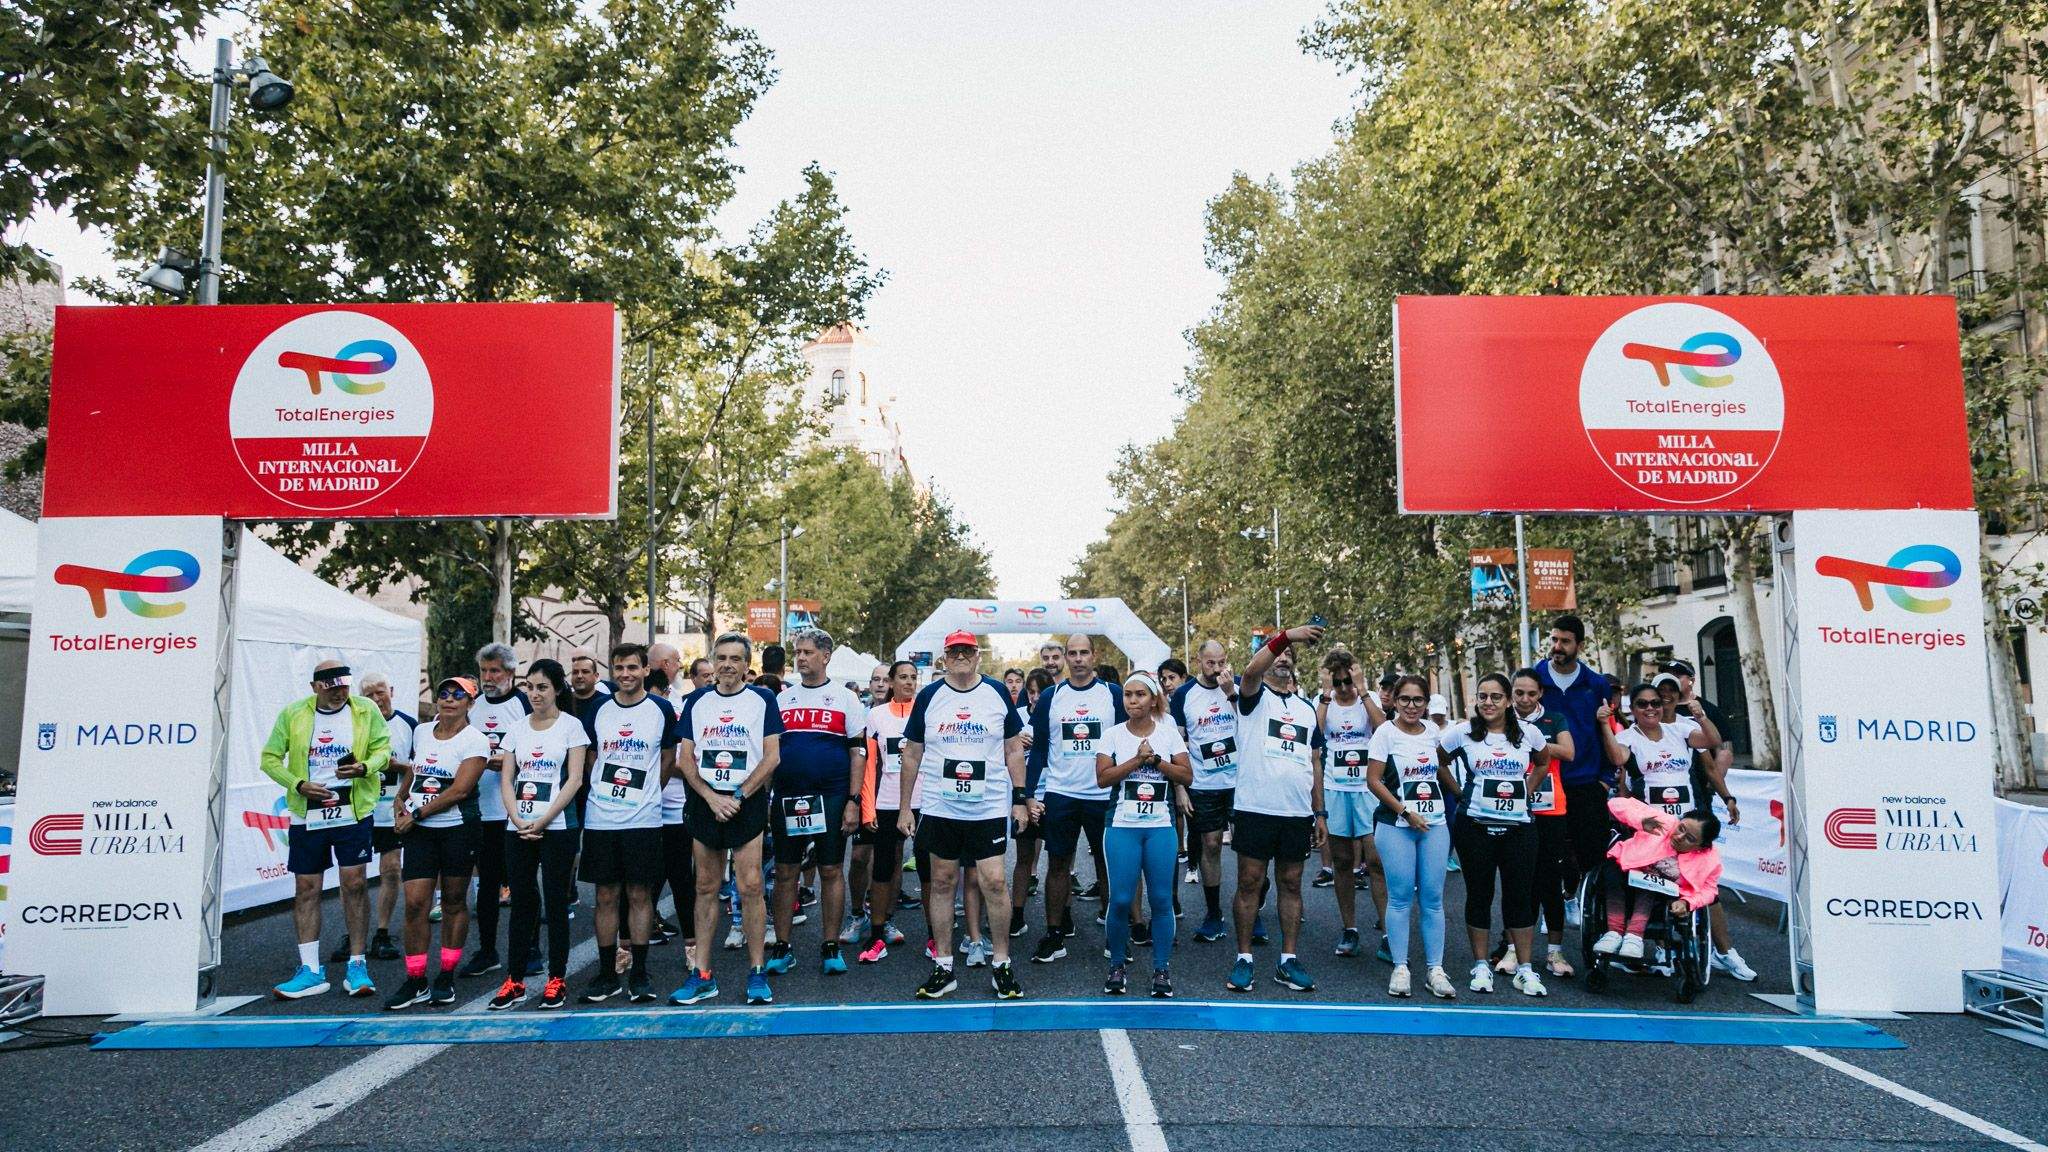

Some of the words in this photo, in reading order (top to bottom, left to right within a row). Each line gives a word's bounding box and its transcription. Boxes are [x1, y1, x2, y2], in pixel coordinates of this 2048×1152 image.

[1626, 399, 1746, 417] TotalEnergies
[275, 407, 395, 424] TotalEnergies
[1657, 435, 1715, 448] MILLA
[302, 442, 359, 456] MILLA
[1637, 470, 1663, 484] DE
[1667, 470, 1738, 484] MADRID
[279, 477, 304, 492] DE
[308, 477, 380, 491] MADRID
[1472, 555, 1493, 564] ISLA
[50, 633, 197, 654] TotalEnergies
[1818, 627, 1966, 650] TotalEnergies
[77, 723, 197, 745] MADRID
[1857, 719, 1976, 742] MADRID
[1073, 740, 1091, 751] 313
[1281, 740, 1294, 753] 44
[1214, 755, 1231, 768] 104
[715, 769, 730, 782] 94
[1346, 767, 1360, 778] 40
[611, 785, 627, 799] 64
[956, 780, 971, 793] 55
[92, 800, 112, 808] new
[115, 799, 158, 808] balance
[1494, 799, 1514, 811] 129
[1882, 796, 1902, 804] new
[1904, 795, 1947, 804] balance
[320, 807, 342, 820] 122
[520, 801, 533, 813] 93
[1136, 801, 1154, 814] 121
[1416, 801, 1434, 813] 128
[1662, 804, 1682, 815] 130
[93, 812, 173, 831] MILLA
[795, 815, 813, 828] 101
[1886, 809, 1964, 828] MILLA
[90, 835, 185, 855] URBANA
[1885, 832, 1979, 852] URBANA
